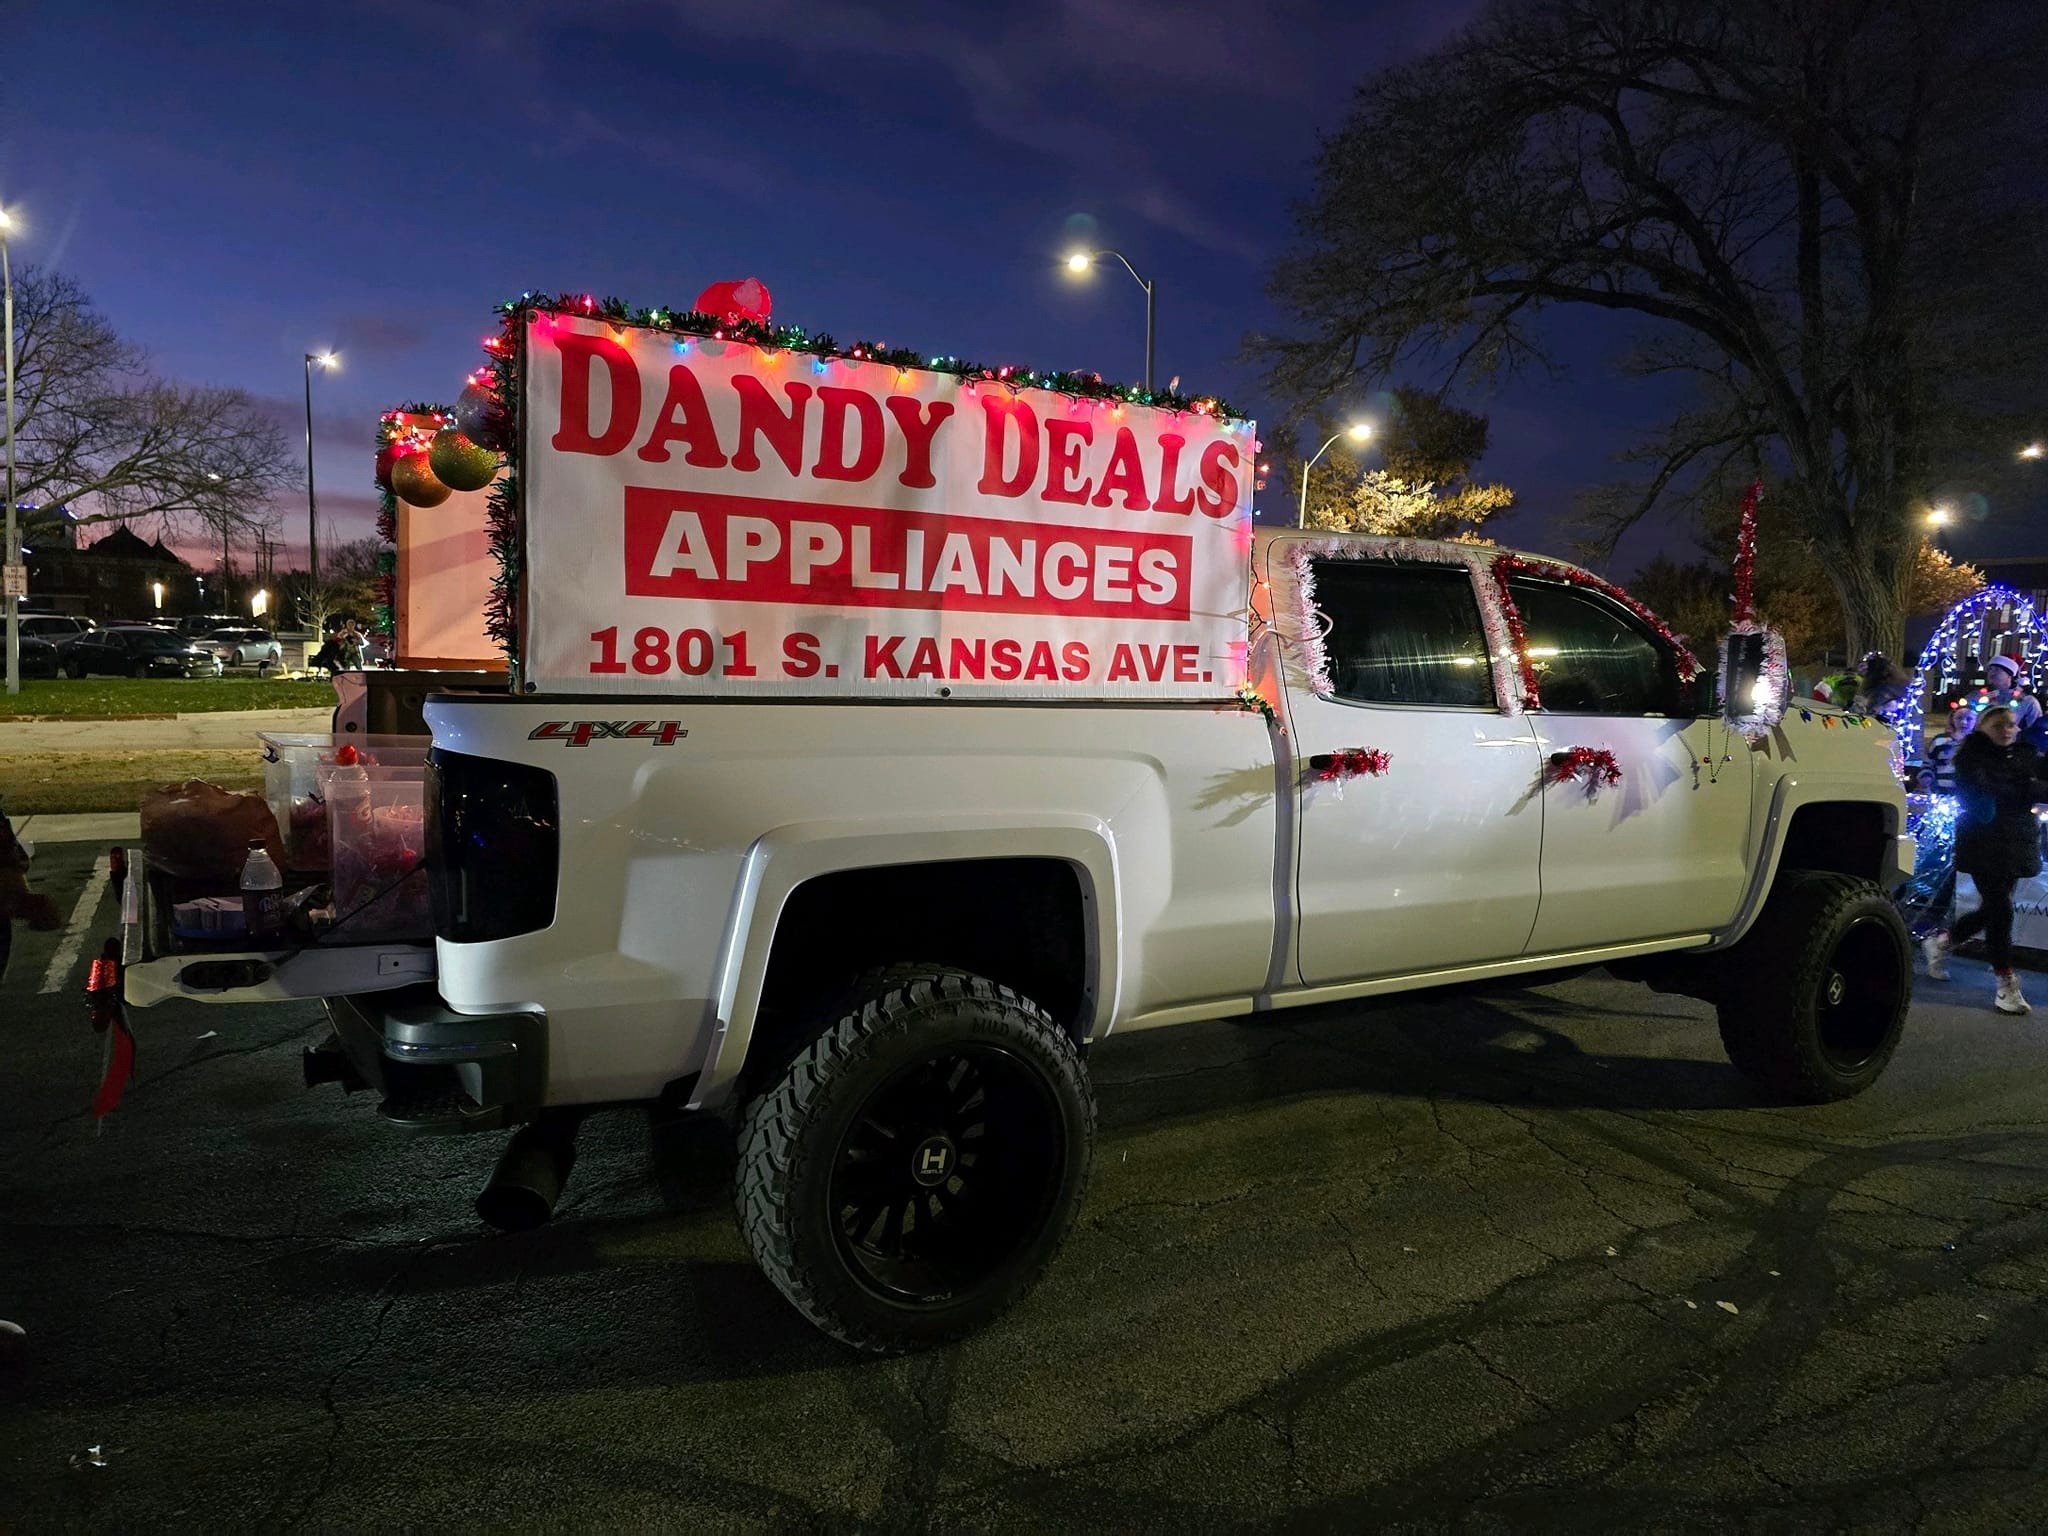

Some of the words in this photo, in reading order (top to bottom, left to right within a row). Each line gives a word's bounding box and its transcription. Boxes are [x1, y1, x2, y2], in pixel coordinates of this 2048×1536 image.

[552, 331, 954, 489] DANDY
[978, 395, 1239, 518] DEALS
[649, 510, 1178, 604] APPLIANCES
[589, 626, 757, 677] 1801
[782, 632, 839, 678] S.
[864, 635, 1091, 682] KANSAS
[1108, 643, 1212, 683] AVE.
[921, 1148, 947, 1170] H
